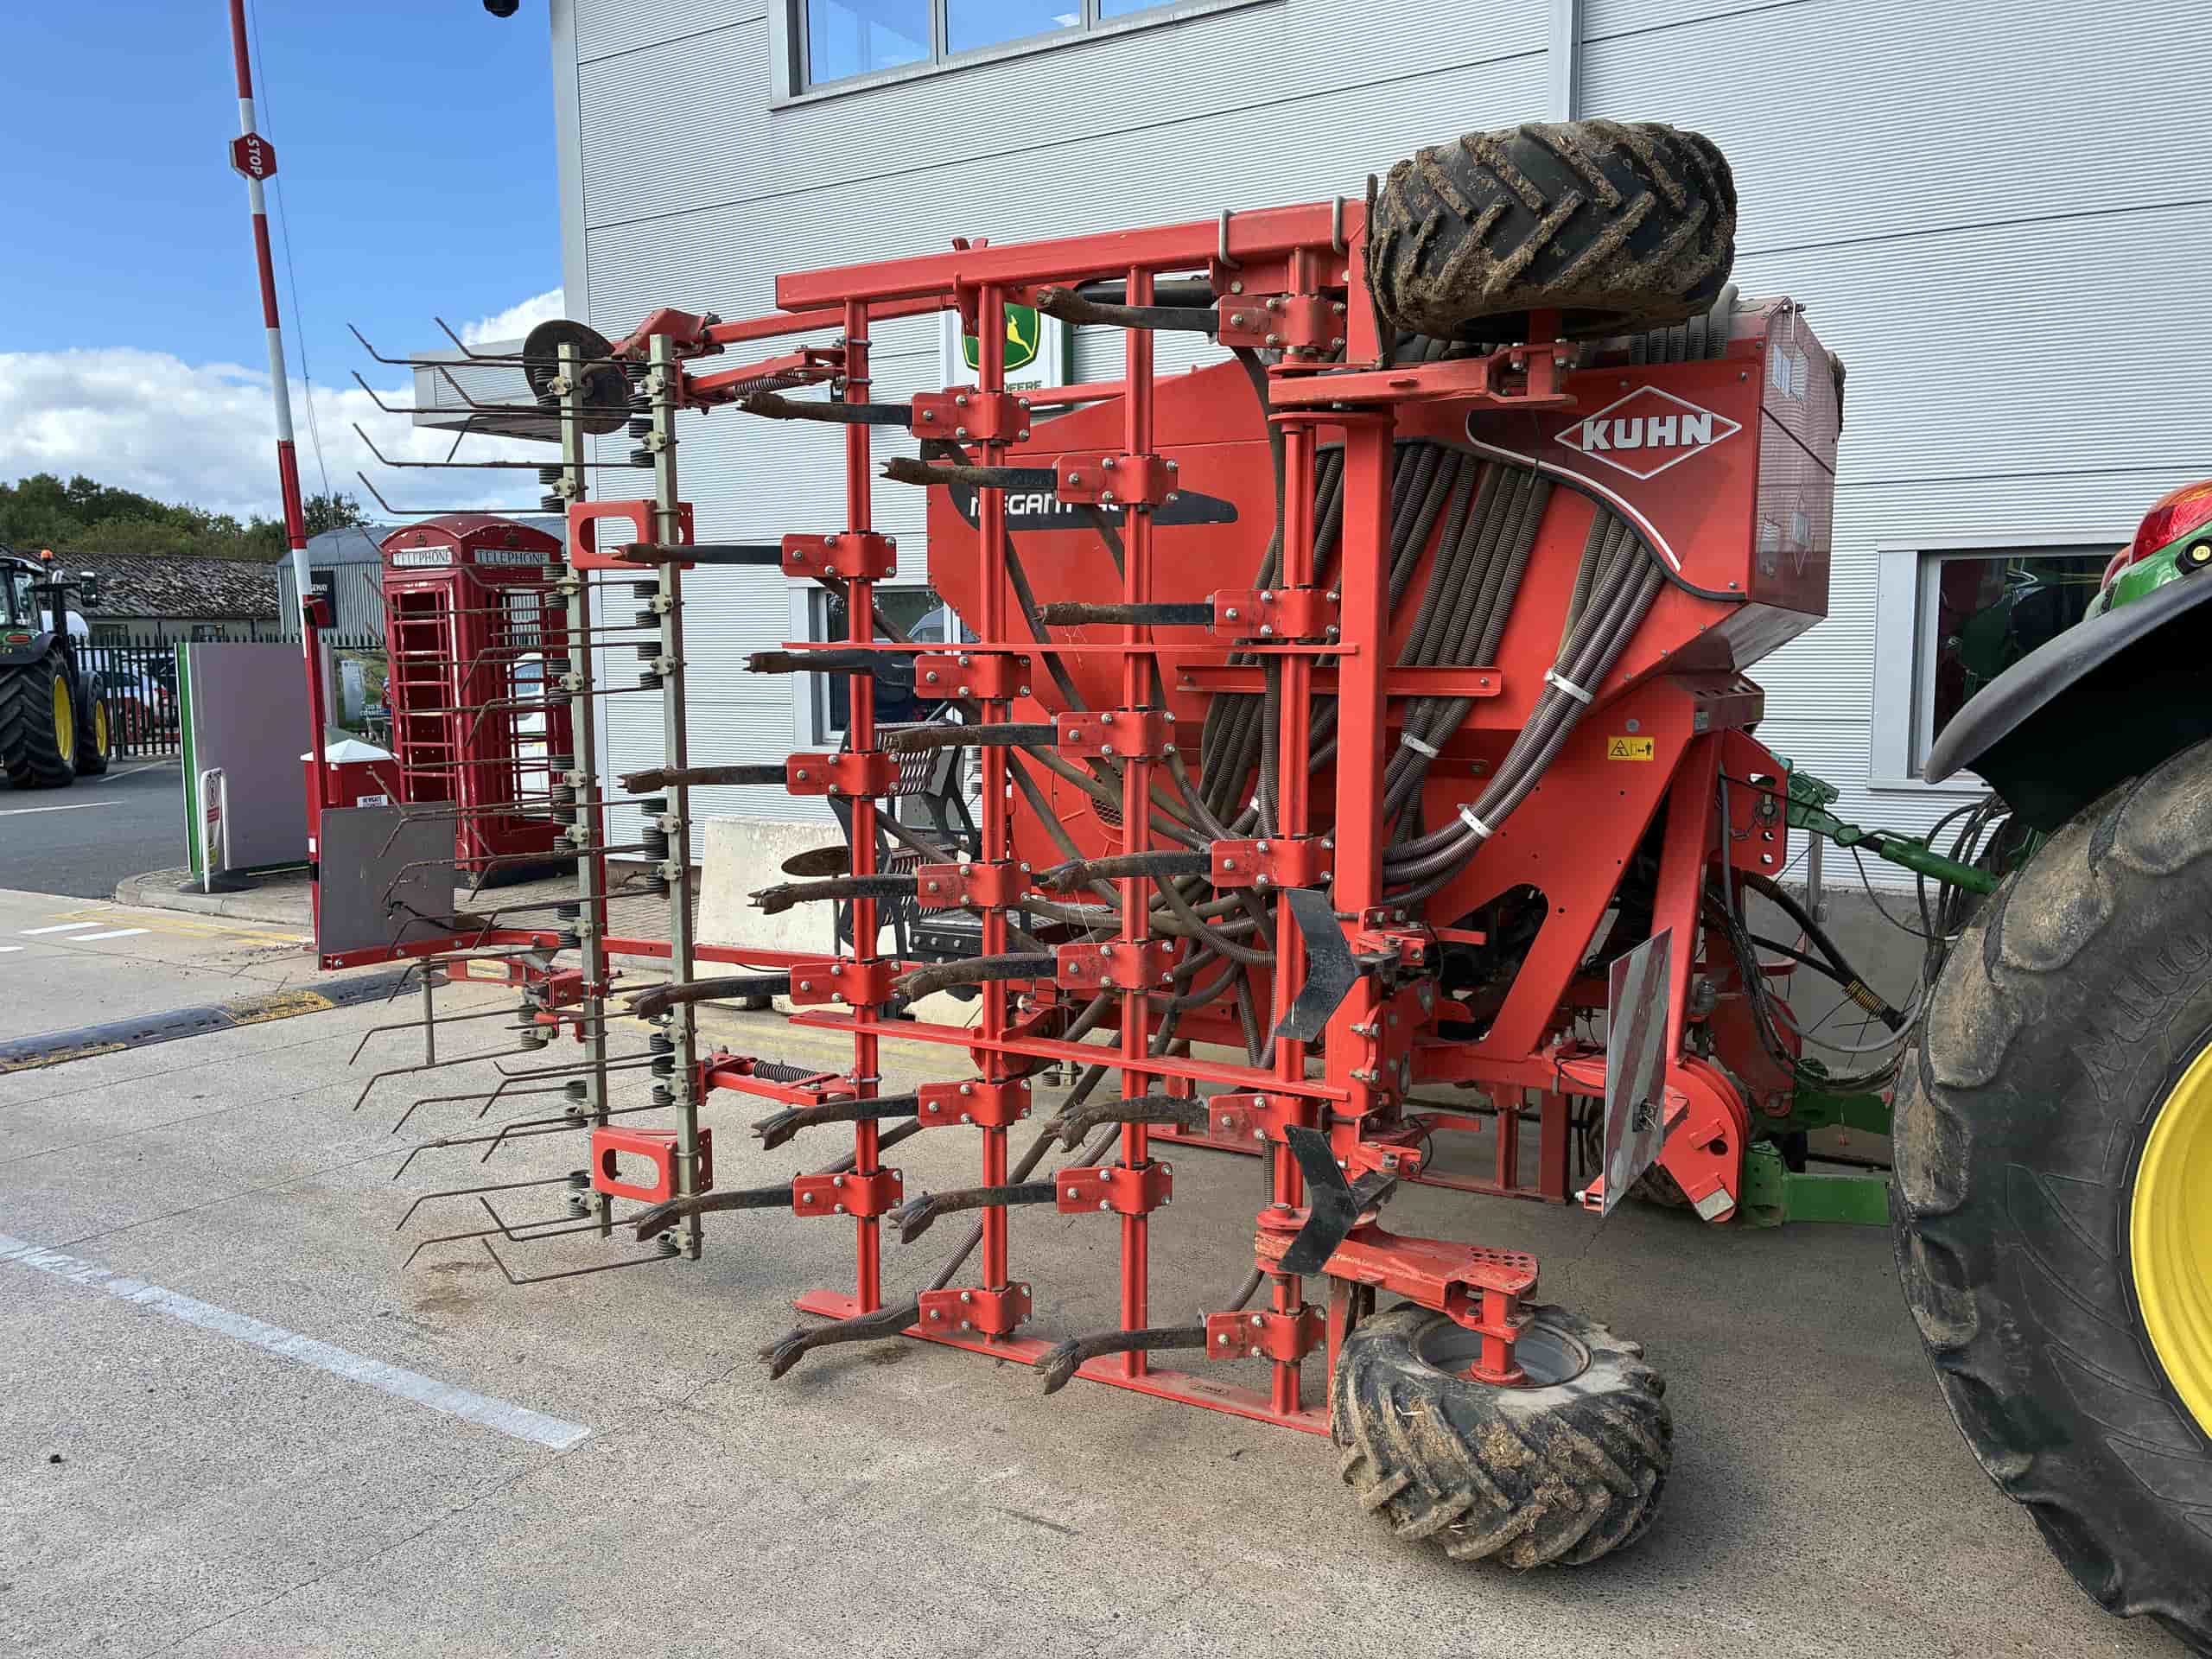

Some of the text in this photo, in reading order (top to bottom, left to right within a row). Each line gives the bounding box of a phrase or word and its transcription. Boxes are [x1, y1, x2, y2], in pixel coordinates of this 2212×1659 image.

[247, 138, 263, 175] STOP
[1582, 413, 1713, 452] KUHN
[970, 493, 1072, 517] GAN
[395, 549, 450, 563] TELEPHONE
[478, 550, 546, 564] TELEPHONE
